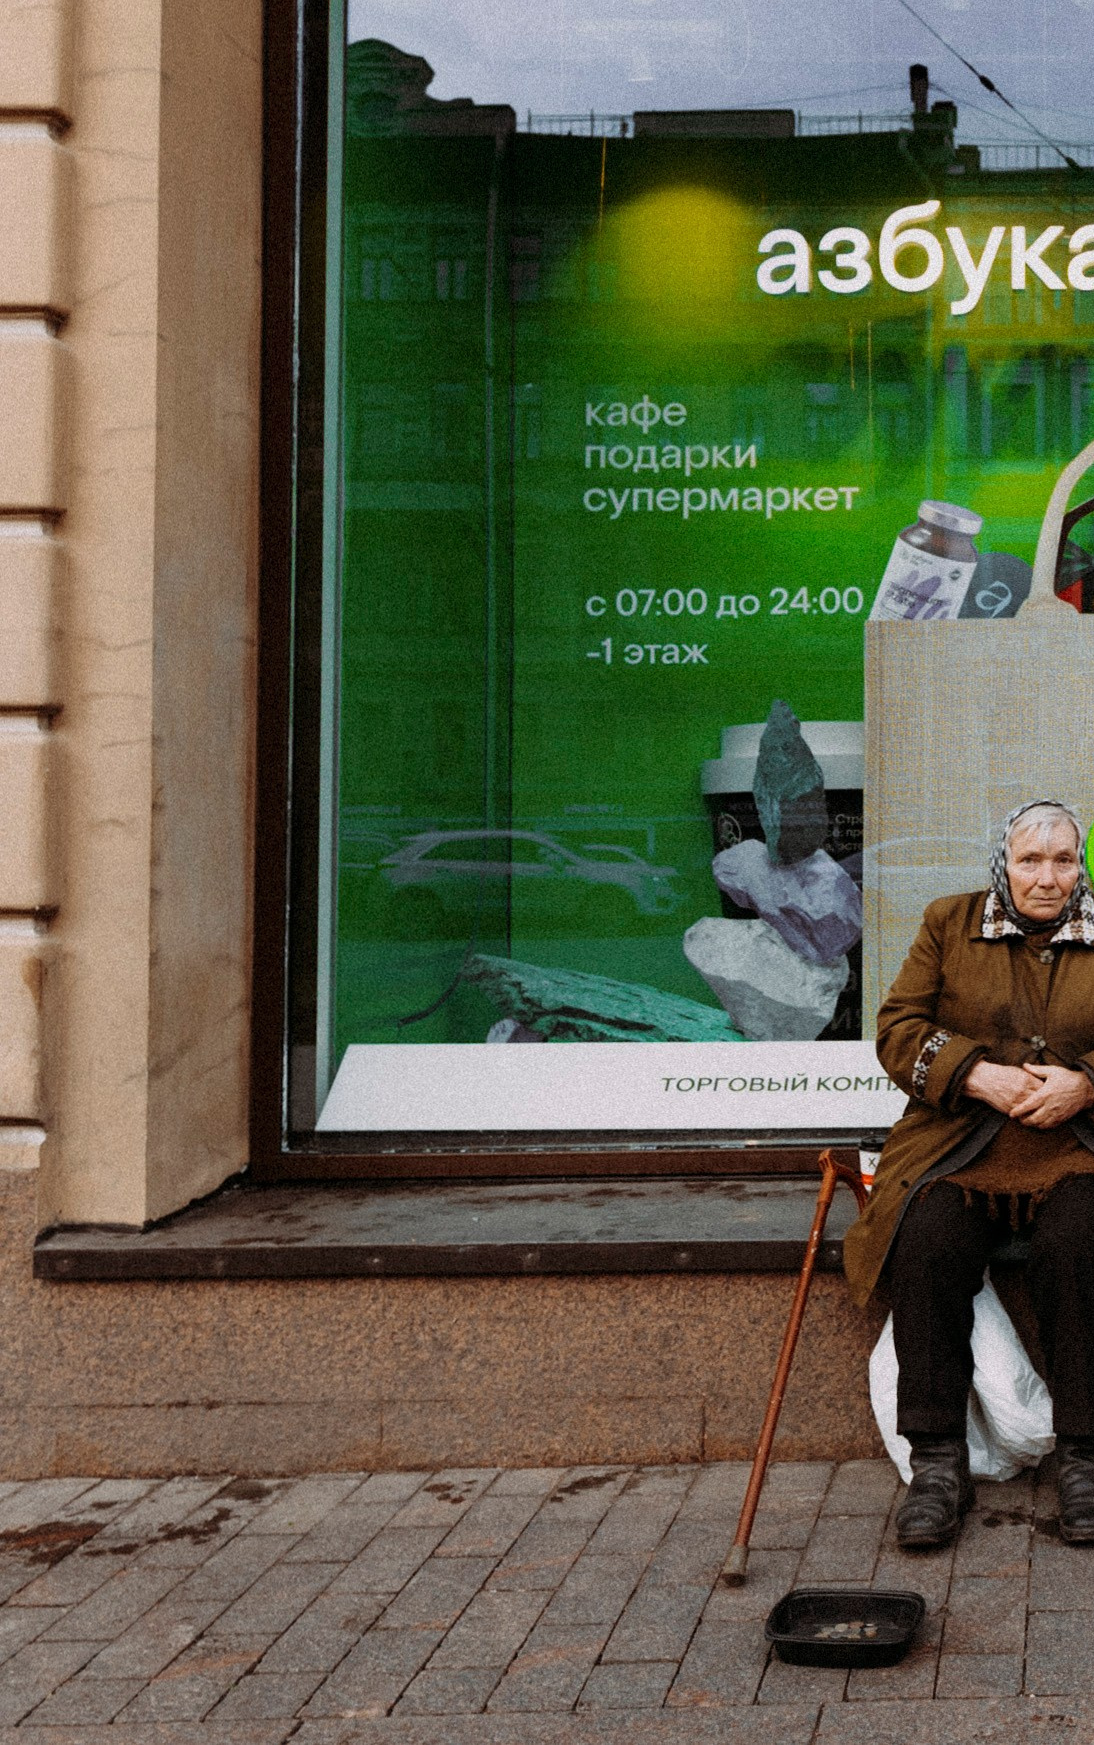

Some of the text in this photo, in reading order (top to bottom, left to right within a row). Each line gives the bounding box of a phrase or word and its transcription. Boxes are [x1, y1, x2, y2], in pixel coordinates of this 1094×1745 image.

[585, 394, 688, 434] кафе
[584, 443, 757, 476] подарки
[583, 486, 860, 520] супермаркет
[586, 596, 606, 616] с
[616, 588, 708, 616] 07:00
[715, 595, 760, 618] до
[769, 587, 863, 615] 24:00
[586, 638, 709, 665] -1 этаж
[662, 1073, 899, 1092] ТОРГОВЫЙ КОМП
